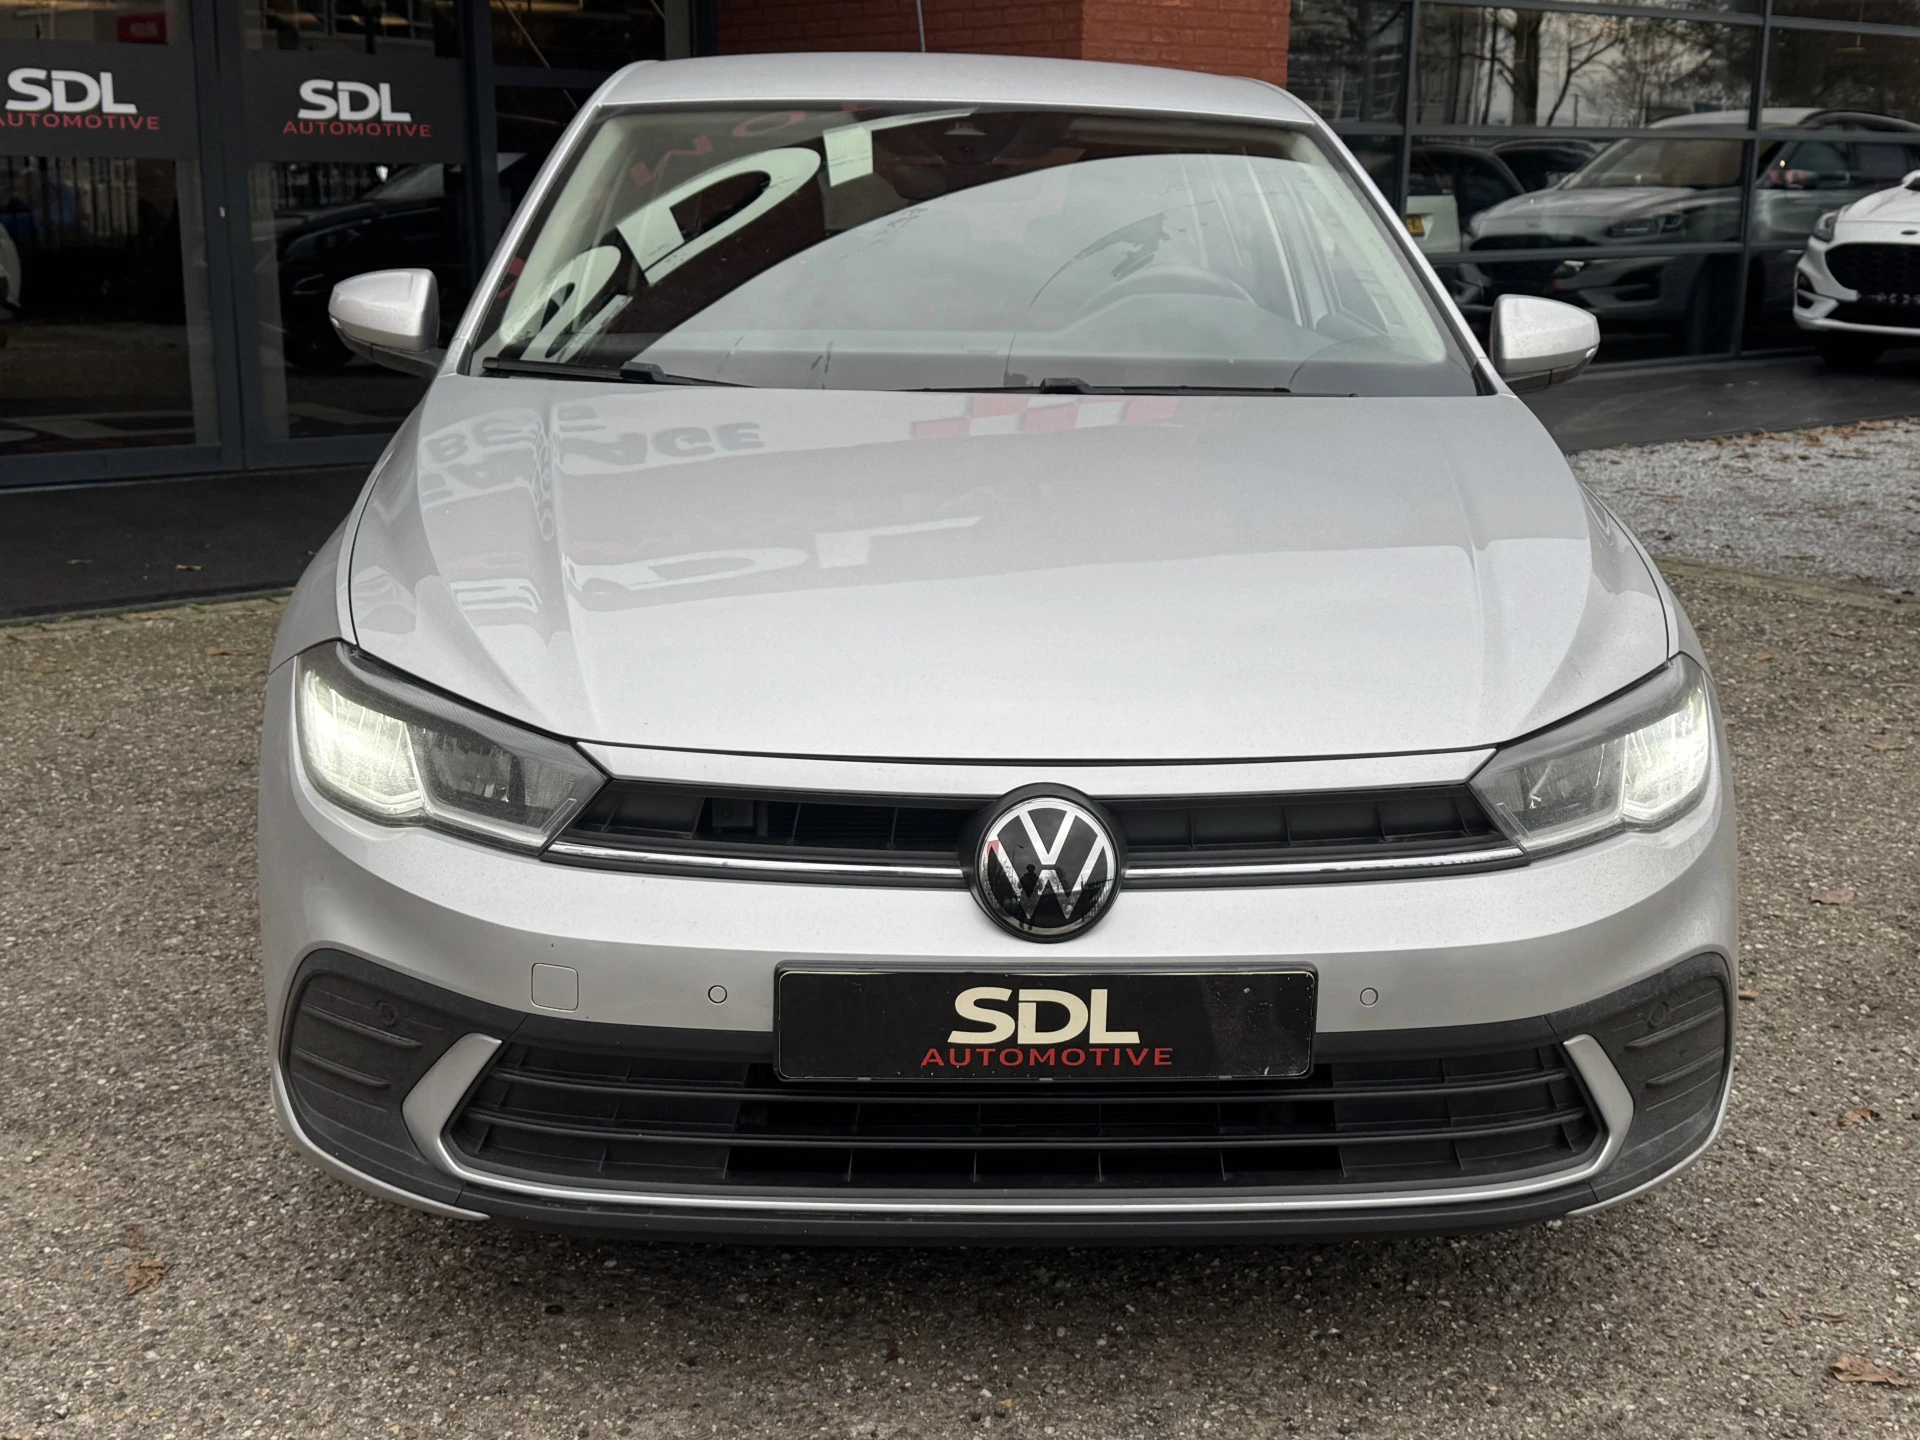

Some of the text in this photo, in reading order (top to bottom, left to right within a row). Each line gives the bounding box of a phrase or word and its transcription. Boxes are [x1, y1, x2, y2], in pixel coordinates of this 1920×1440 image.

[5, 67, 138, 114] SDL
[297, 79, 412, 122] SDL
[283, 120, 431, 137] AUTOMOTIVE
[947, 986, 1140, 1044] SDL
[921, 1048, 1173, 1066] AUTOMOTIVE
